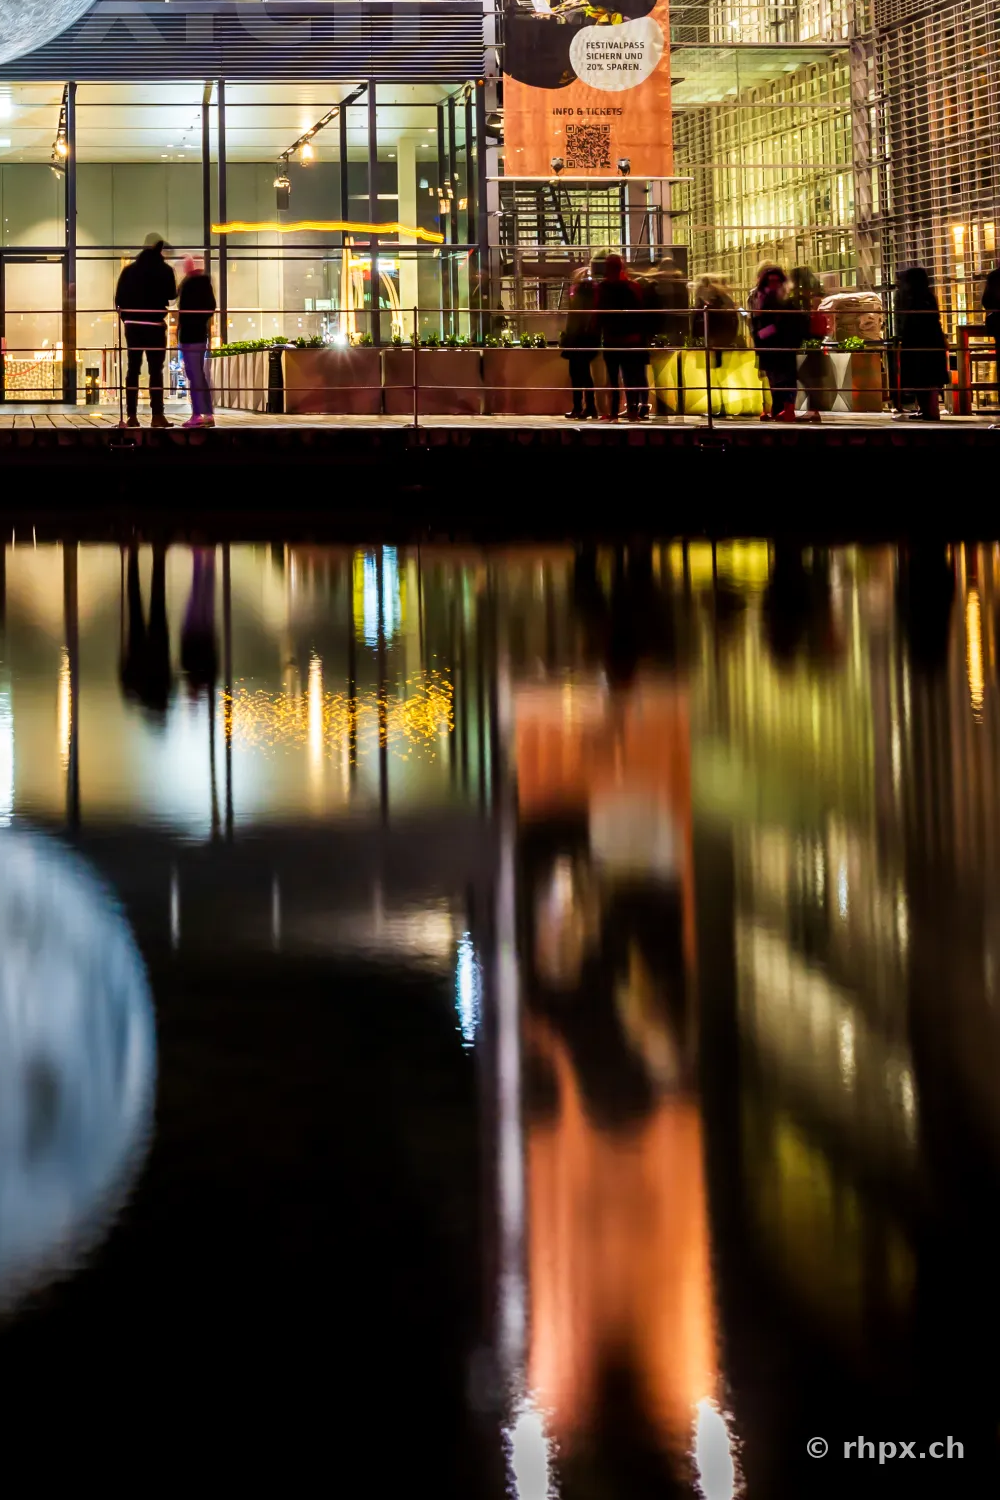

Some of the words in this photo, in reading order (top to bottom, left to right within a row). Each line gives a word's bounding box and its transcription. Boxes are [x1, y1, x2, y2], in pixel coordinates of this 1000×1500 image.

[586, 41, 645, 50] FESTIVALPASS
[586, 52, 622, 60] SICHERN
[625, 52, 643, 60] UND
[586, 63, 604, 71] 20%
[606, 63, 642, 71] SPAREN.
[552, 108, 574, 116] INFO
[576, 108, 583, 116] &
[585, 107, 623, 116] TICKETS
